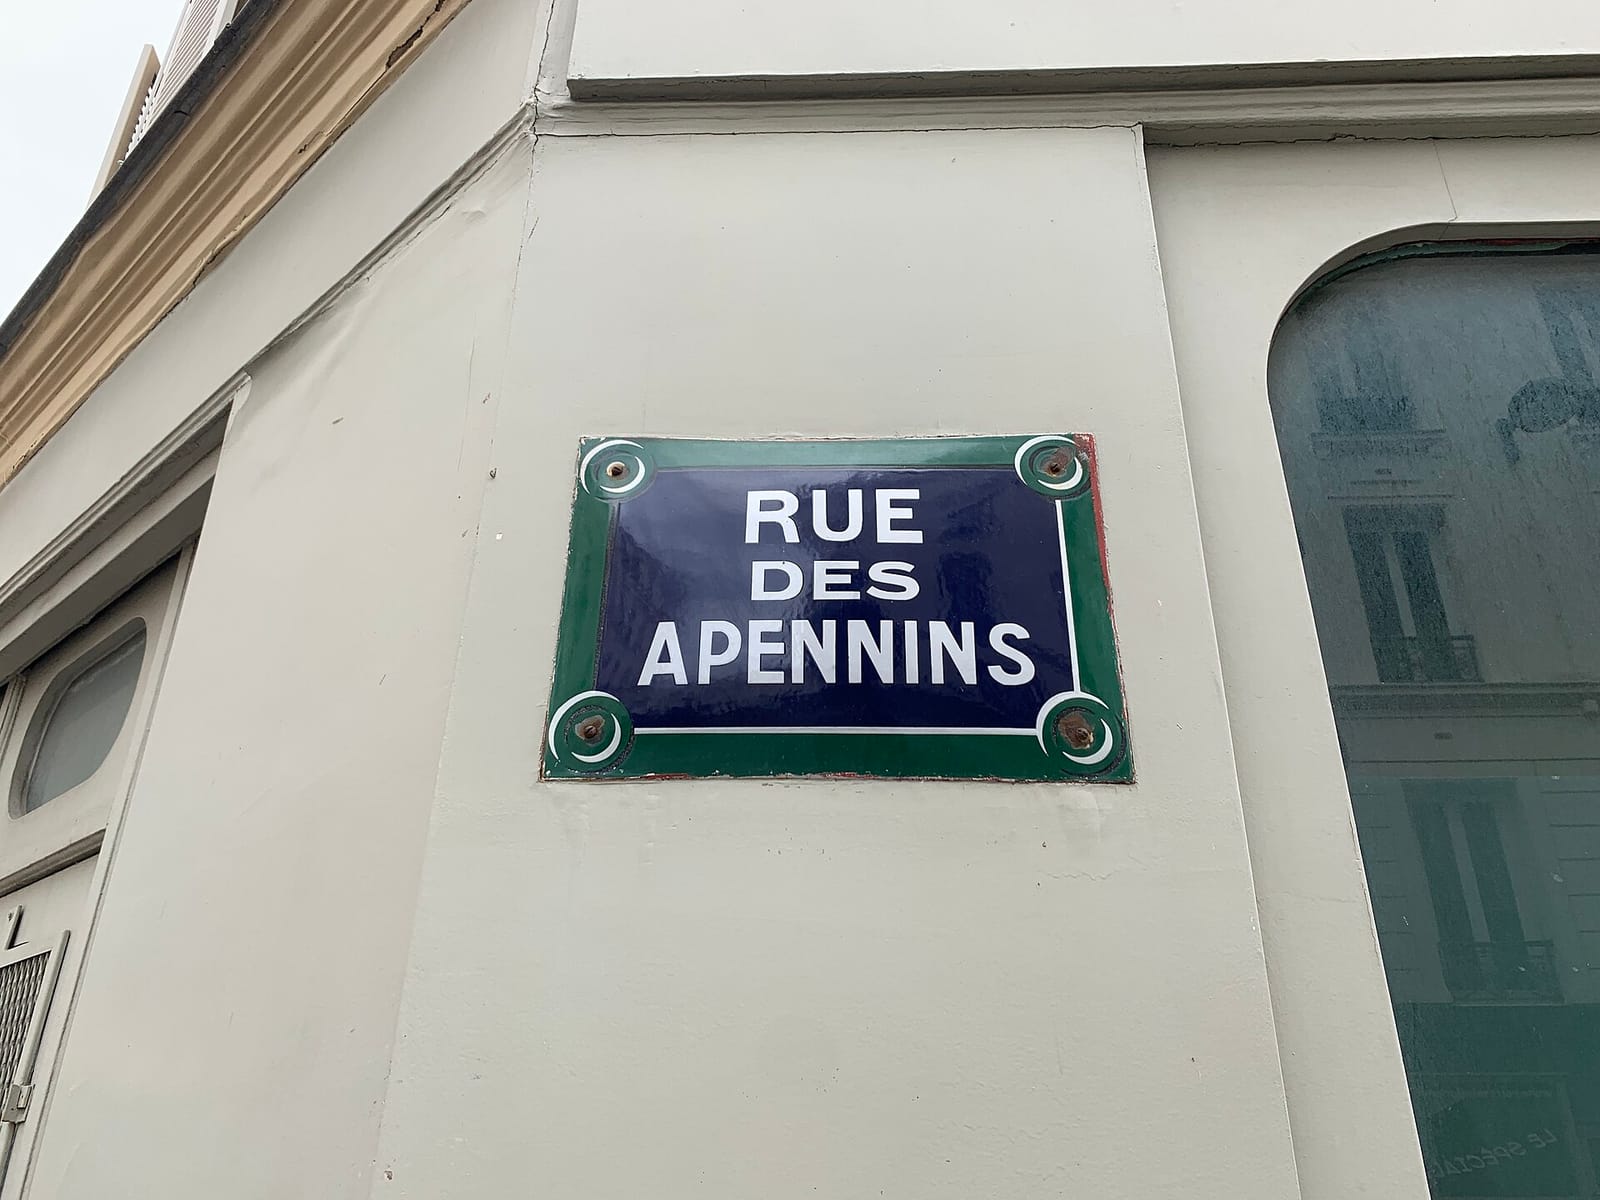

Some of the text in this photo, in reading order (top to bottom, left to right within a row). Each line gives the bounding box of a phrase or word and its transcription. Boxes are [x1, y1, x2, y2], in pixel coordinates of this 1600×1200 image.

[745, 489, 924, 543] RUE
[751, 560, 920, 600] DES
[638, 620, 1036, 685] APENNINS
